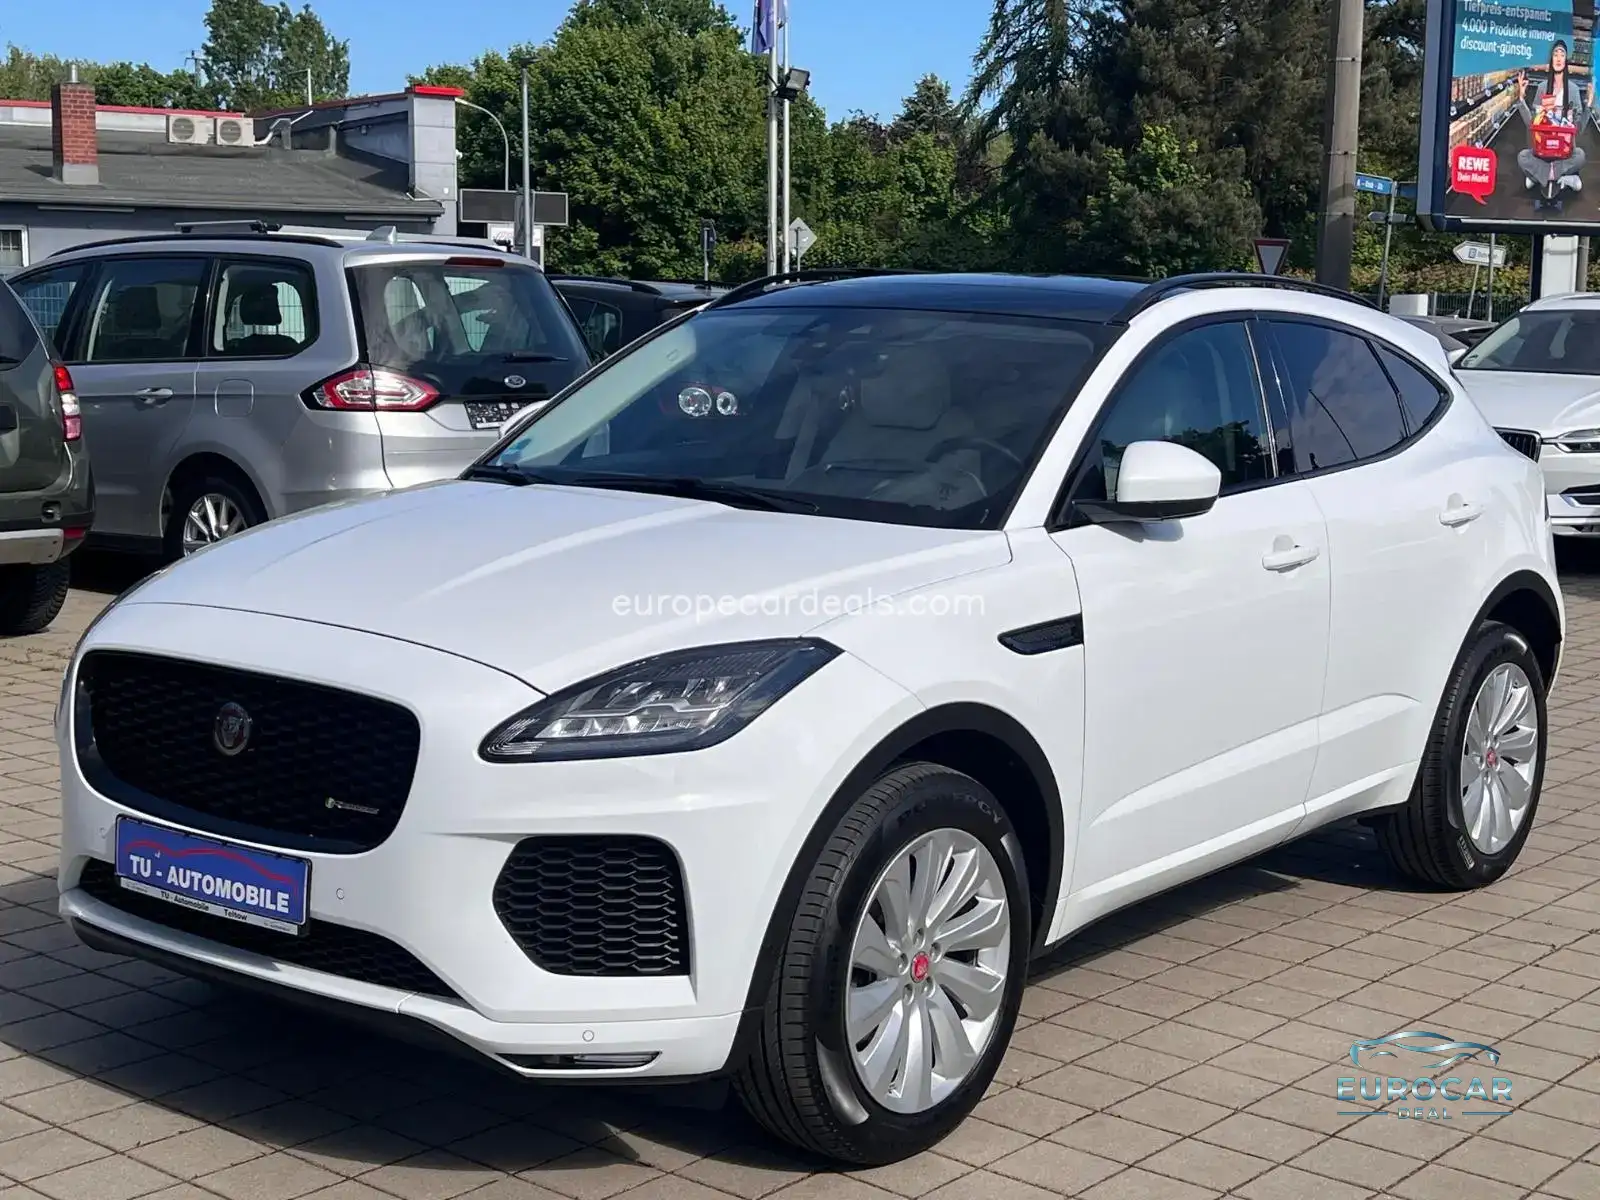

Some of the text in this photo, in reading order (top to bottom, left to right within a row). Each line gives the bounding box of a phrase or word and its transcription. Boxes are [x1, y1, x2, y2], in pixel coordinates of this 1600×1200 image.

[1461, 18, 1556, 41] 4.000 Produkte immer
[1458, 155, 1490, 171] REWE
[129, 854, 151, 878] TU
[166, 865, 290, 914] AUTOMOBILE
[223, 908, 248, 921] Teltow
